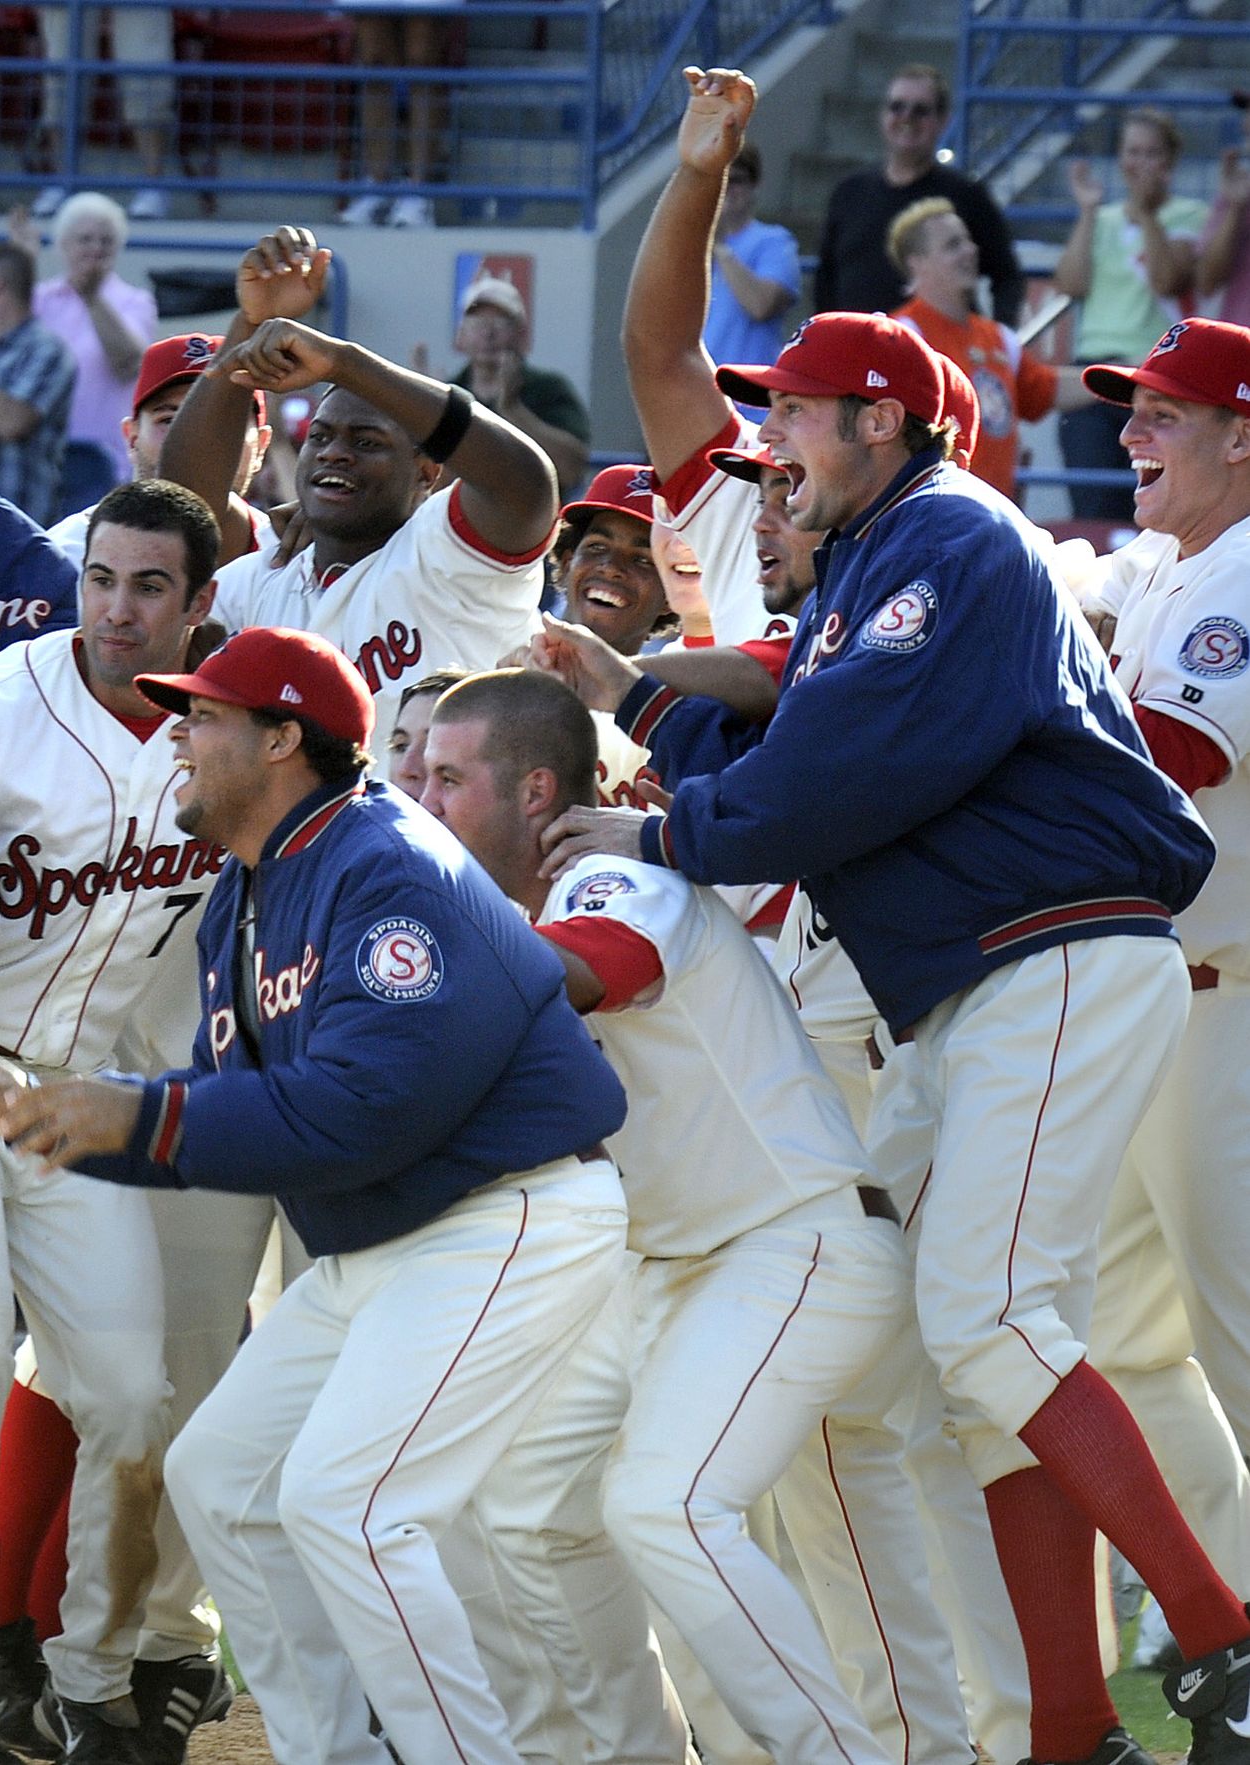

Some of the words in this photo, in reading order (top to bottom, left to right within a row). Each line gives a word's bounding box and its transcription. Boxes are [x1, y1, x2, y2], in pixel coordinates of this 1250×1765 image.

[146, 892, 204, 958] 7
[388, 939, 418, 980] S
[1180, 1667, 1203, 1691] NIKE
